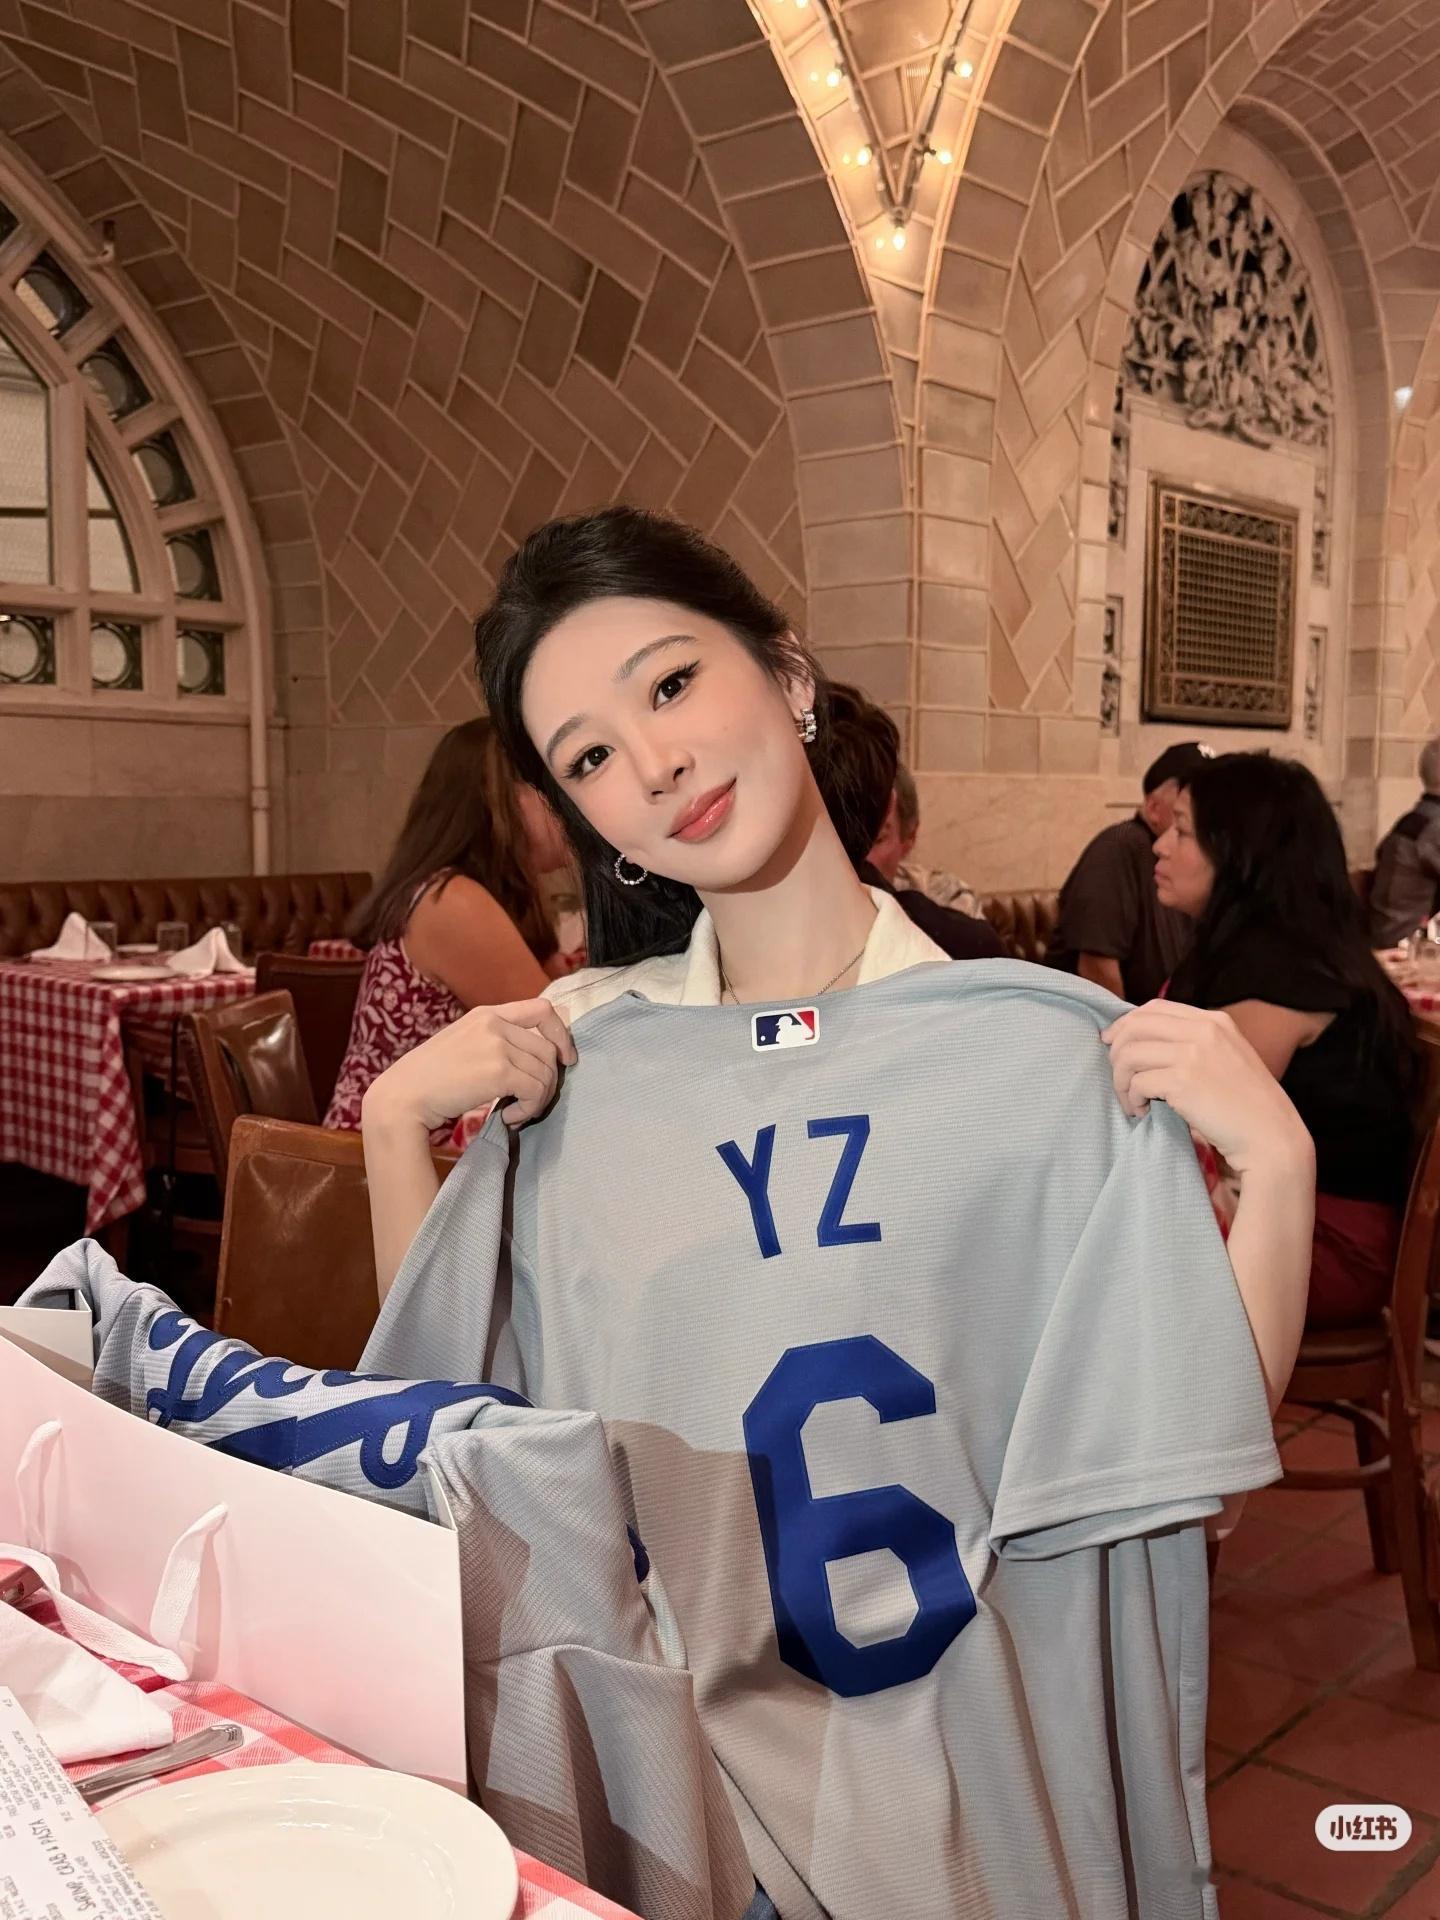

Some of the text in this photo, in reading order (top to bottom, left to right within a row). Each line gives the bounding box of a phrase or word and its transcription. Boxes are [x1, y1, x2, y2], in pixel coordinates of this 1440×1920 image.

[715, 1114, 882, 1259] YZ
[742, 1334, 978, 1698] 6
[28, 1818, 57, 1845] PASTA
[48, 1853, 75, 1875] CRAB
